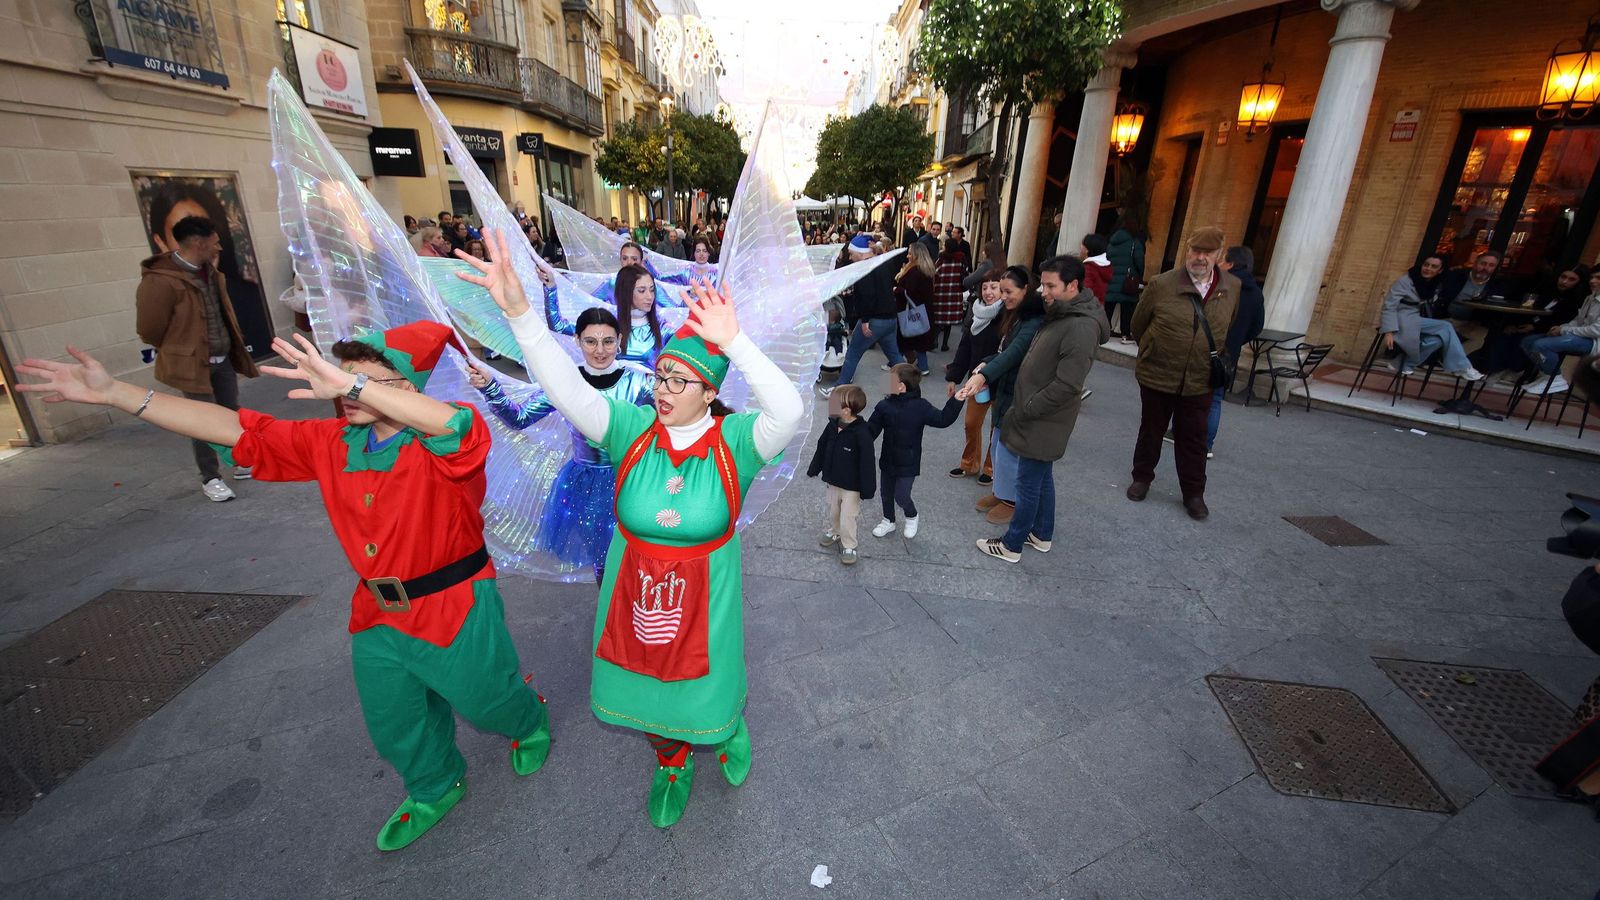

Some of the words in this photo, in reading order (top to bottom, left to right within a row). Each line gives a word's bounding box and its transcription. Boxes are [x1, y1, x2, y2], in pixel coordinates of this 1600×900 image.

[144, 57, 161, 70] 607
[164, 62, 175, 73] 64
[177, 65, 188, 76] 64
[190, 68, 200, 78] 60
[375, 147, 412, 155] miramira
